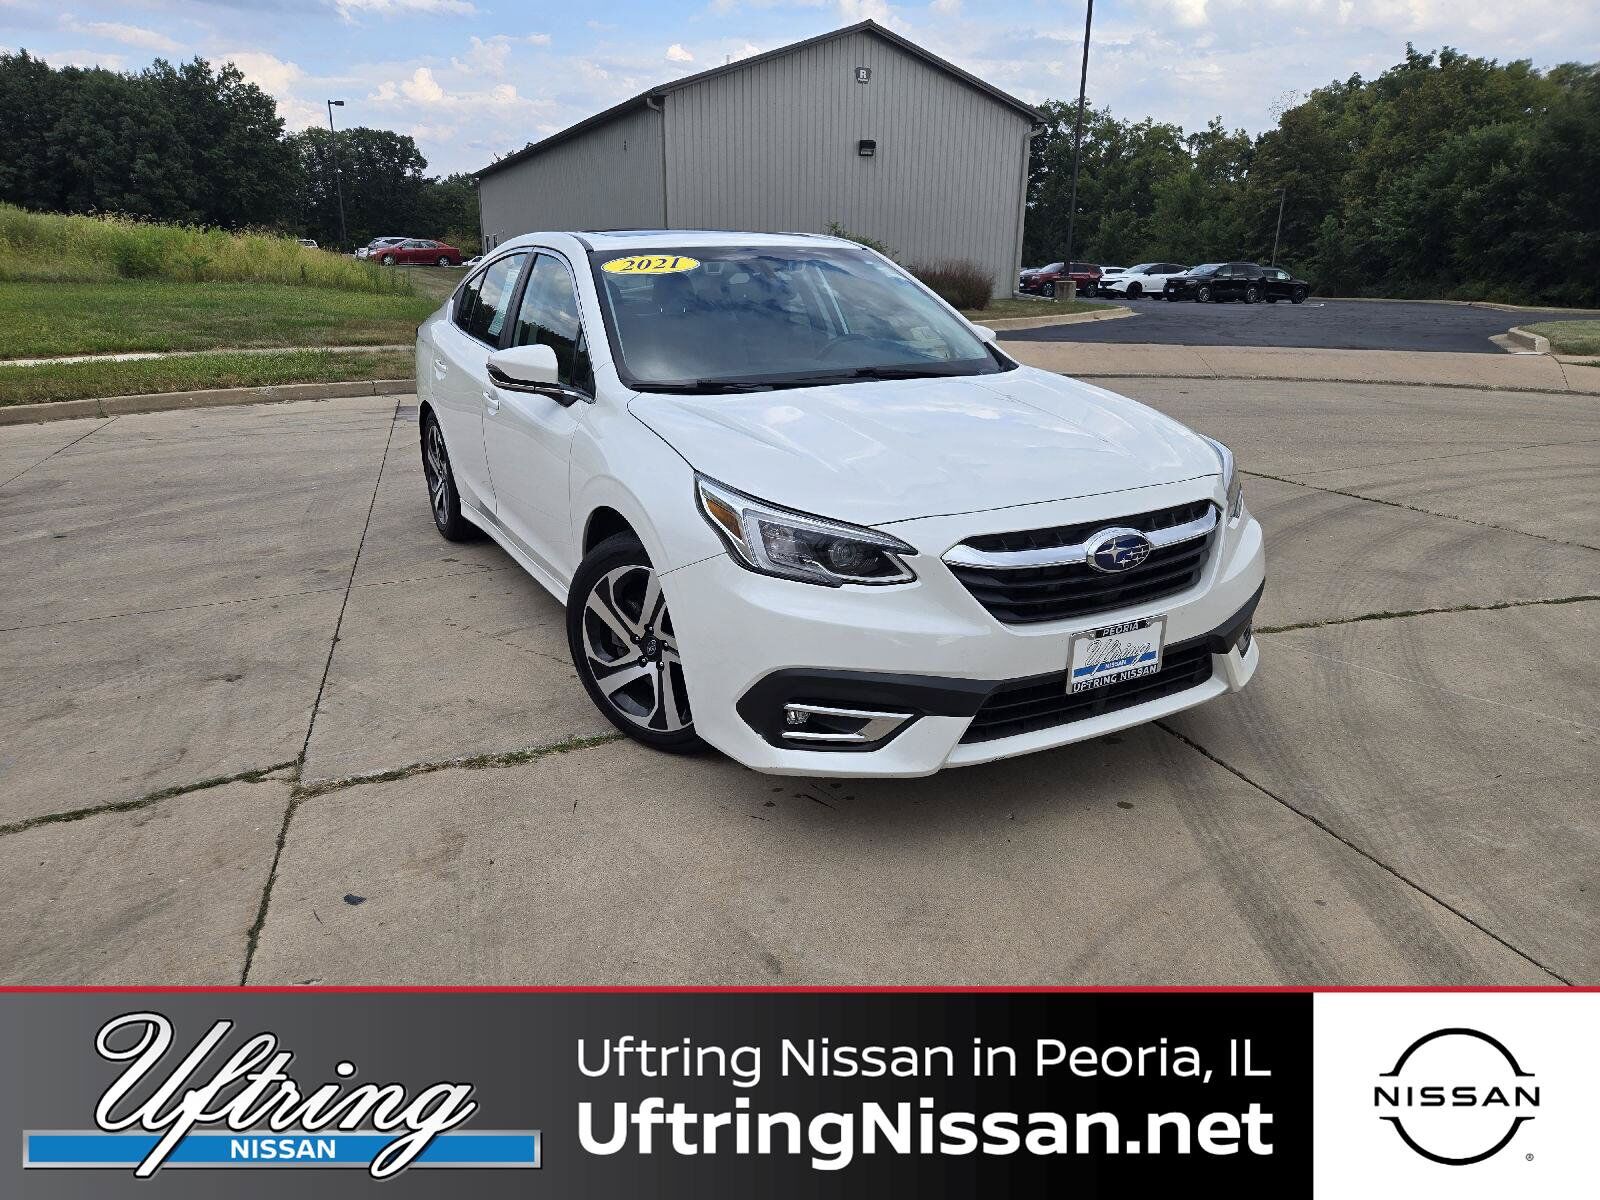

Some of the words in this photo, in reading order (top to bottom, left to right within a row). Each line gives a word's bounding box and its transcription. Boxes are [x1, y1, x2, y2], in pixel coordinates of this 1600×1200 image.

[860, 70, 867, 78] R
[619, 258, 680, 271] 2021
[1102, 622, 1139, 637] PEORIA
[1104, 659, 1127, 670] NISSAN
[1073, 674, 1118, 692] UFTRING
[1120, 664, 1158, 681] NISSAN
